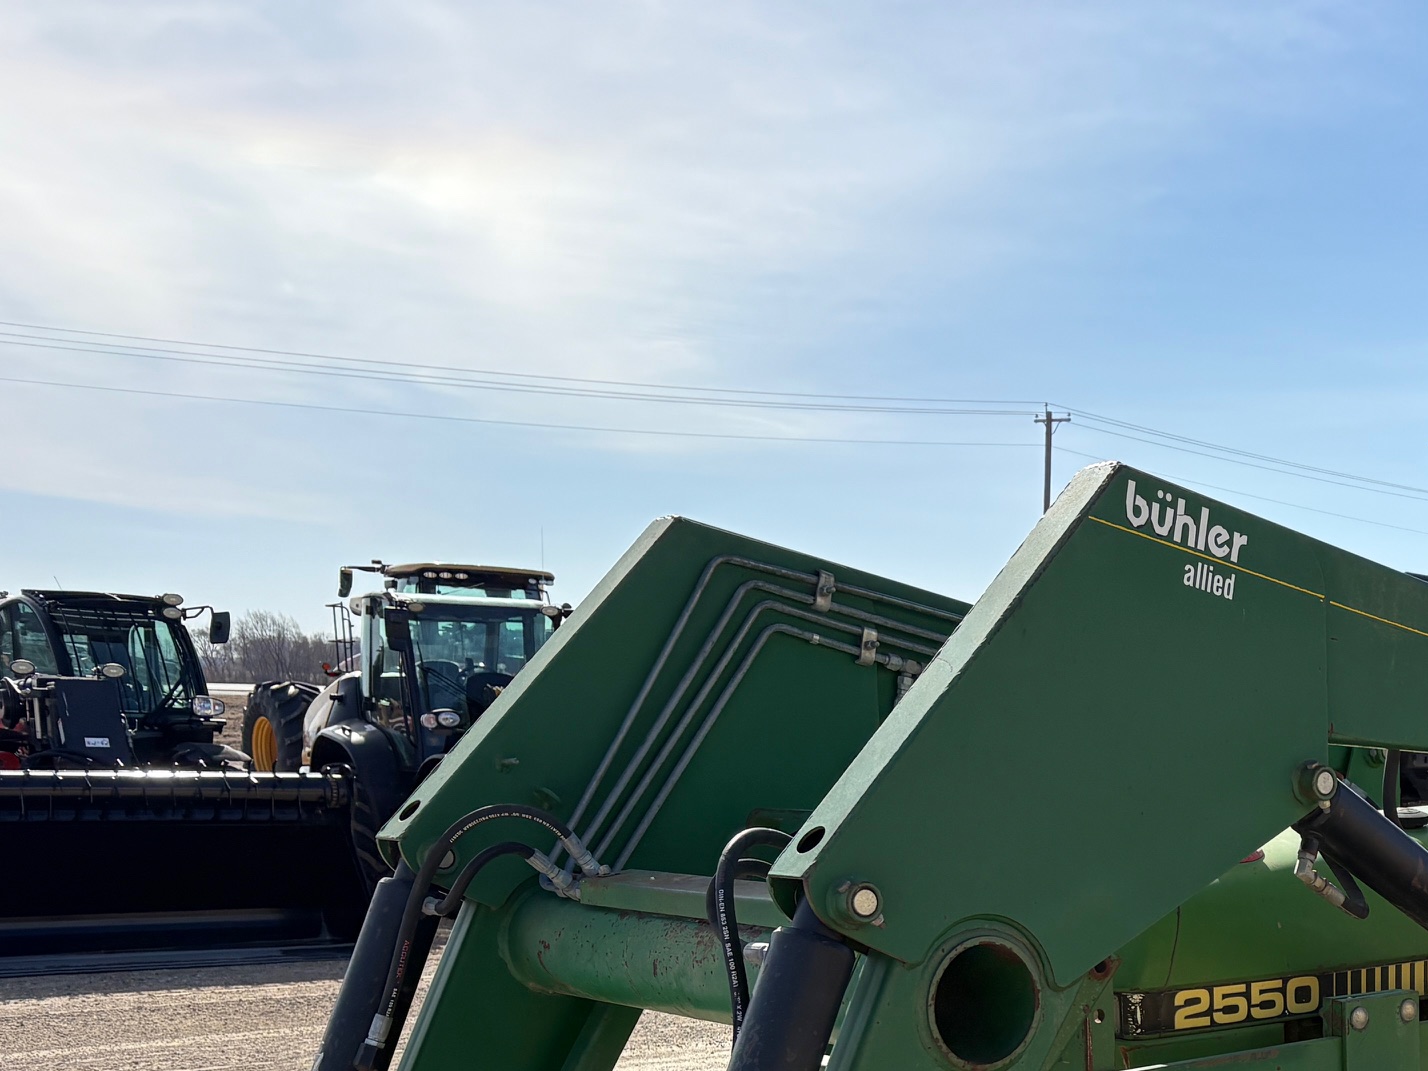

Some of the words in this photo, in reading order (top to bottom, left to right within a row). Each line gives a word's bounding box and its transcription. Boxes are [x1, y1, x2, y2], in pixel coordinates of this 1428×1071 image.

[1125, 479, 1248, 563] bühler
[1183, 562, 1236, 600] allied
[725, 943, 733, 957] SAE
[1174, 976, 1320, 1030] 2550
